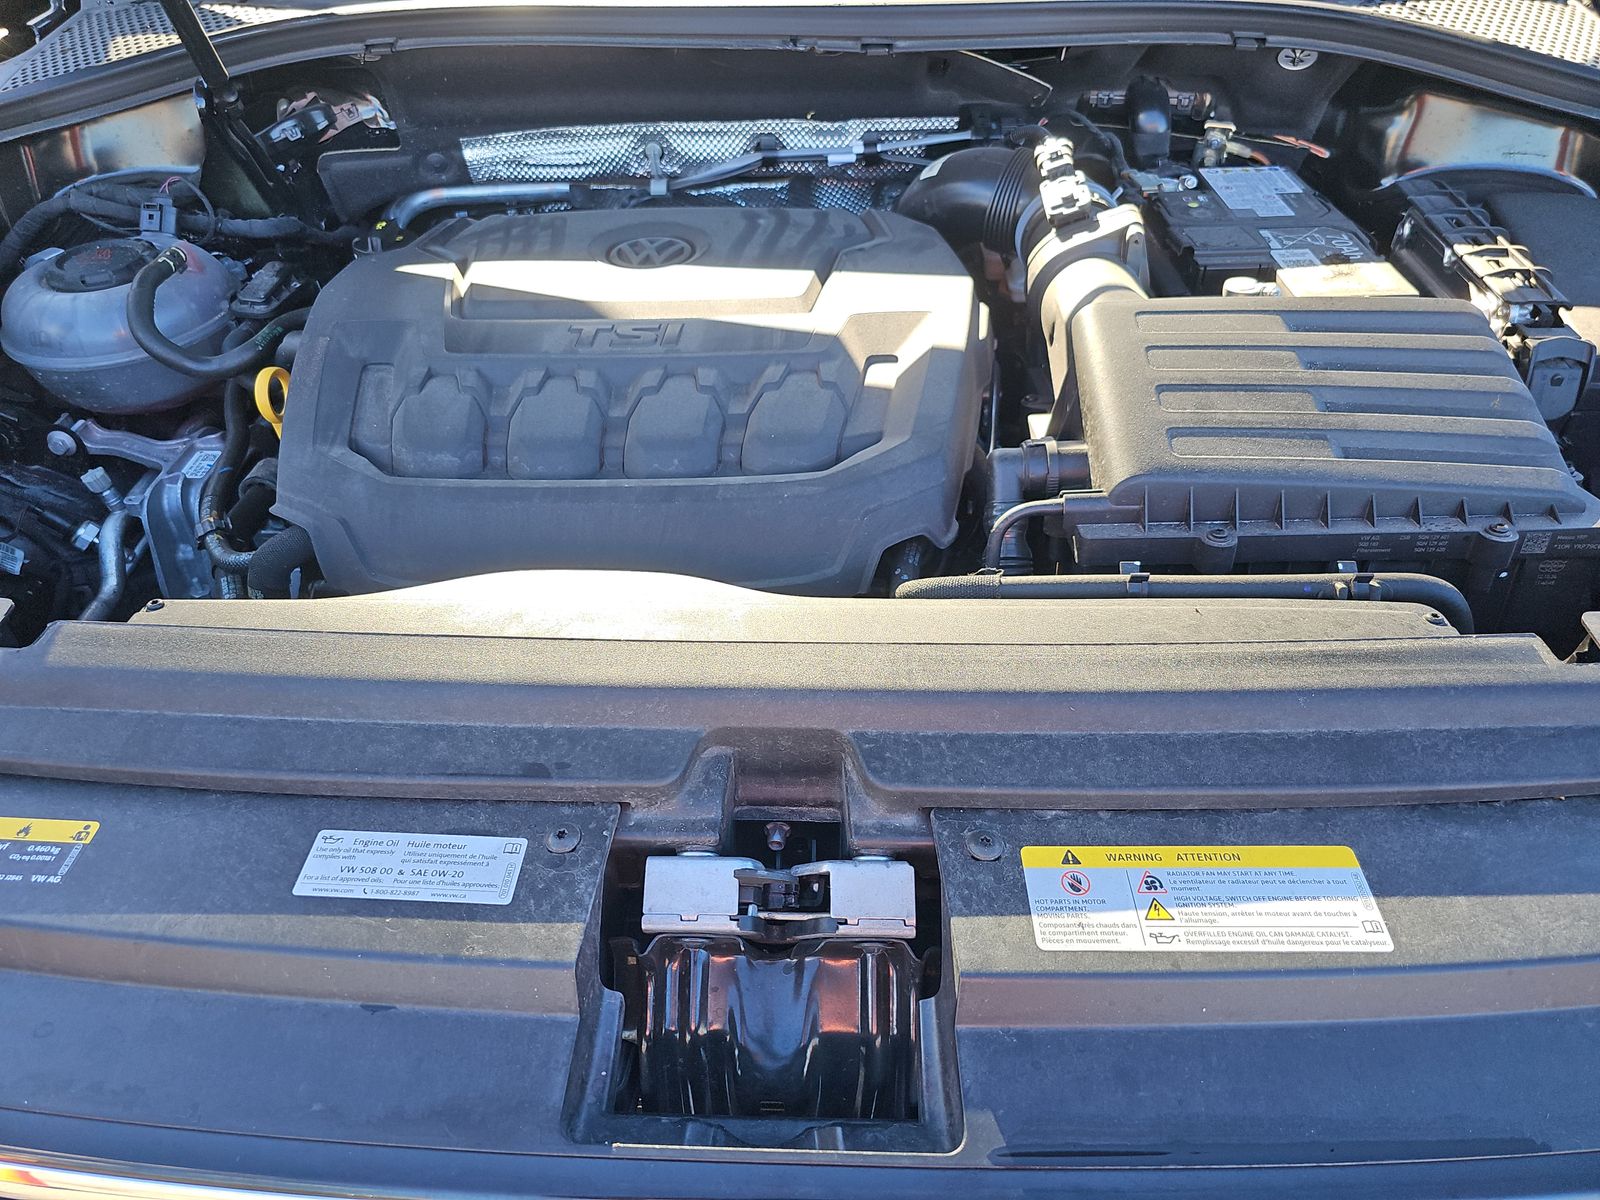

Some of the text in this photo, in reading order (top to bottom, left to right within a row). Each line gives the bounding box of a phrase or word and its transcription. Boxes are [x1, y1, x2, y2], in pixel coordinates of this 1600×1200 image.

[1326, 233, 1364, 259] 70Ah
[568, 322, 685, 348] TSI
[353, 838, 400, 848] Engine Oil
[407, 840, 431, 848] Huile
[428, 852, 468, 860] uniquement
[1105, 853, 1162, 862] WARNING
[1176, 853, 1241, 862] ATTENTION
[340, 866, 358, 874] VW
[360, 866, 378, 874] 508
[380, 867, 393, 875] 00
[410, 868, 429, 877] SAE
[430, 869, 465, 878] 0W-20
[1038, 922, 1080, 930] Composants
[1351, 939, 1390, 947] catalyseur.
